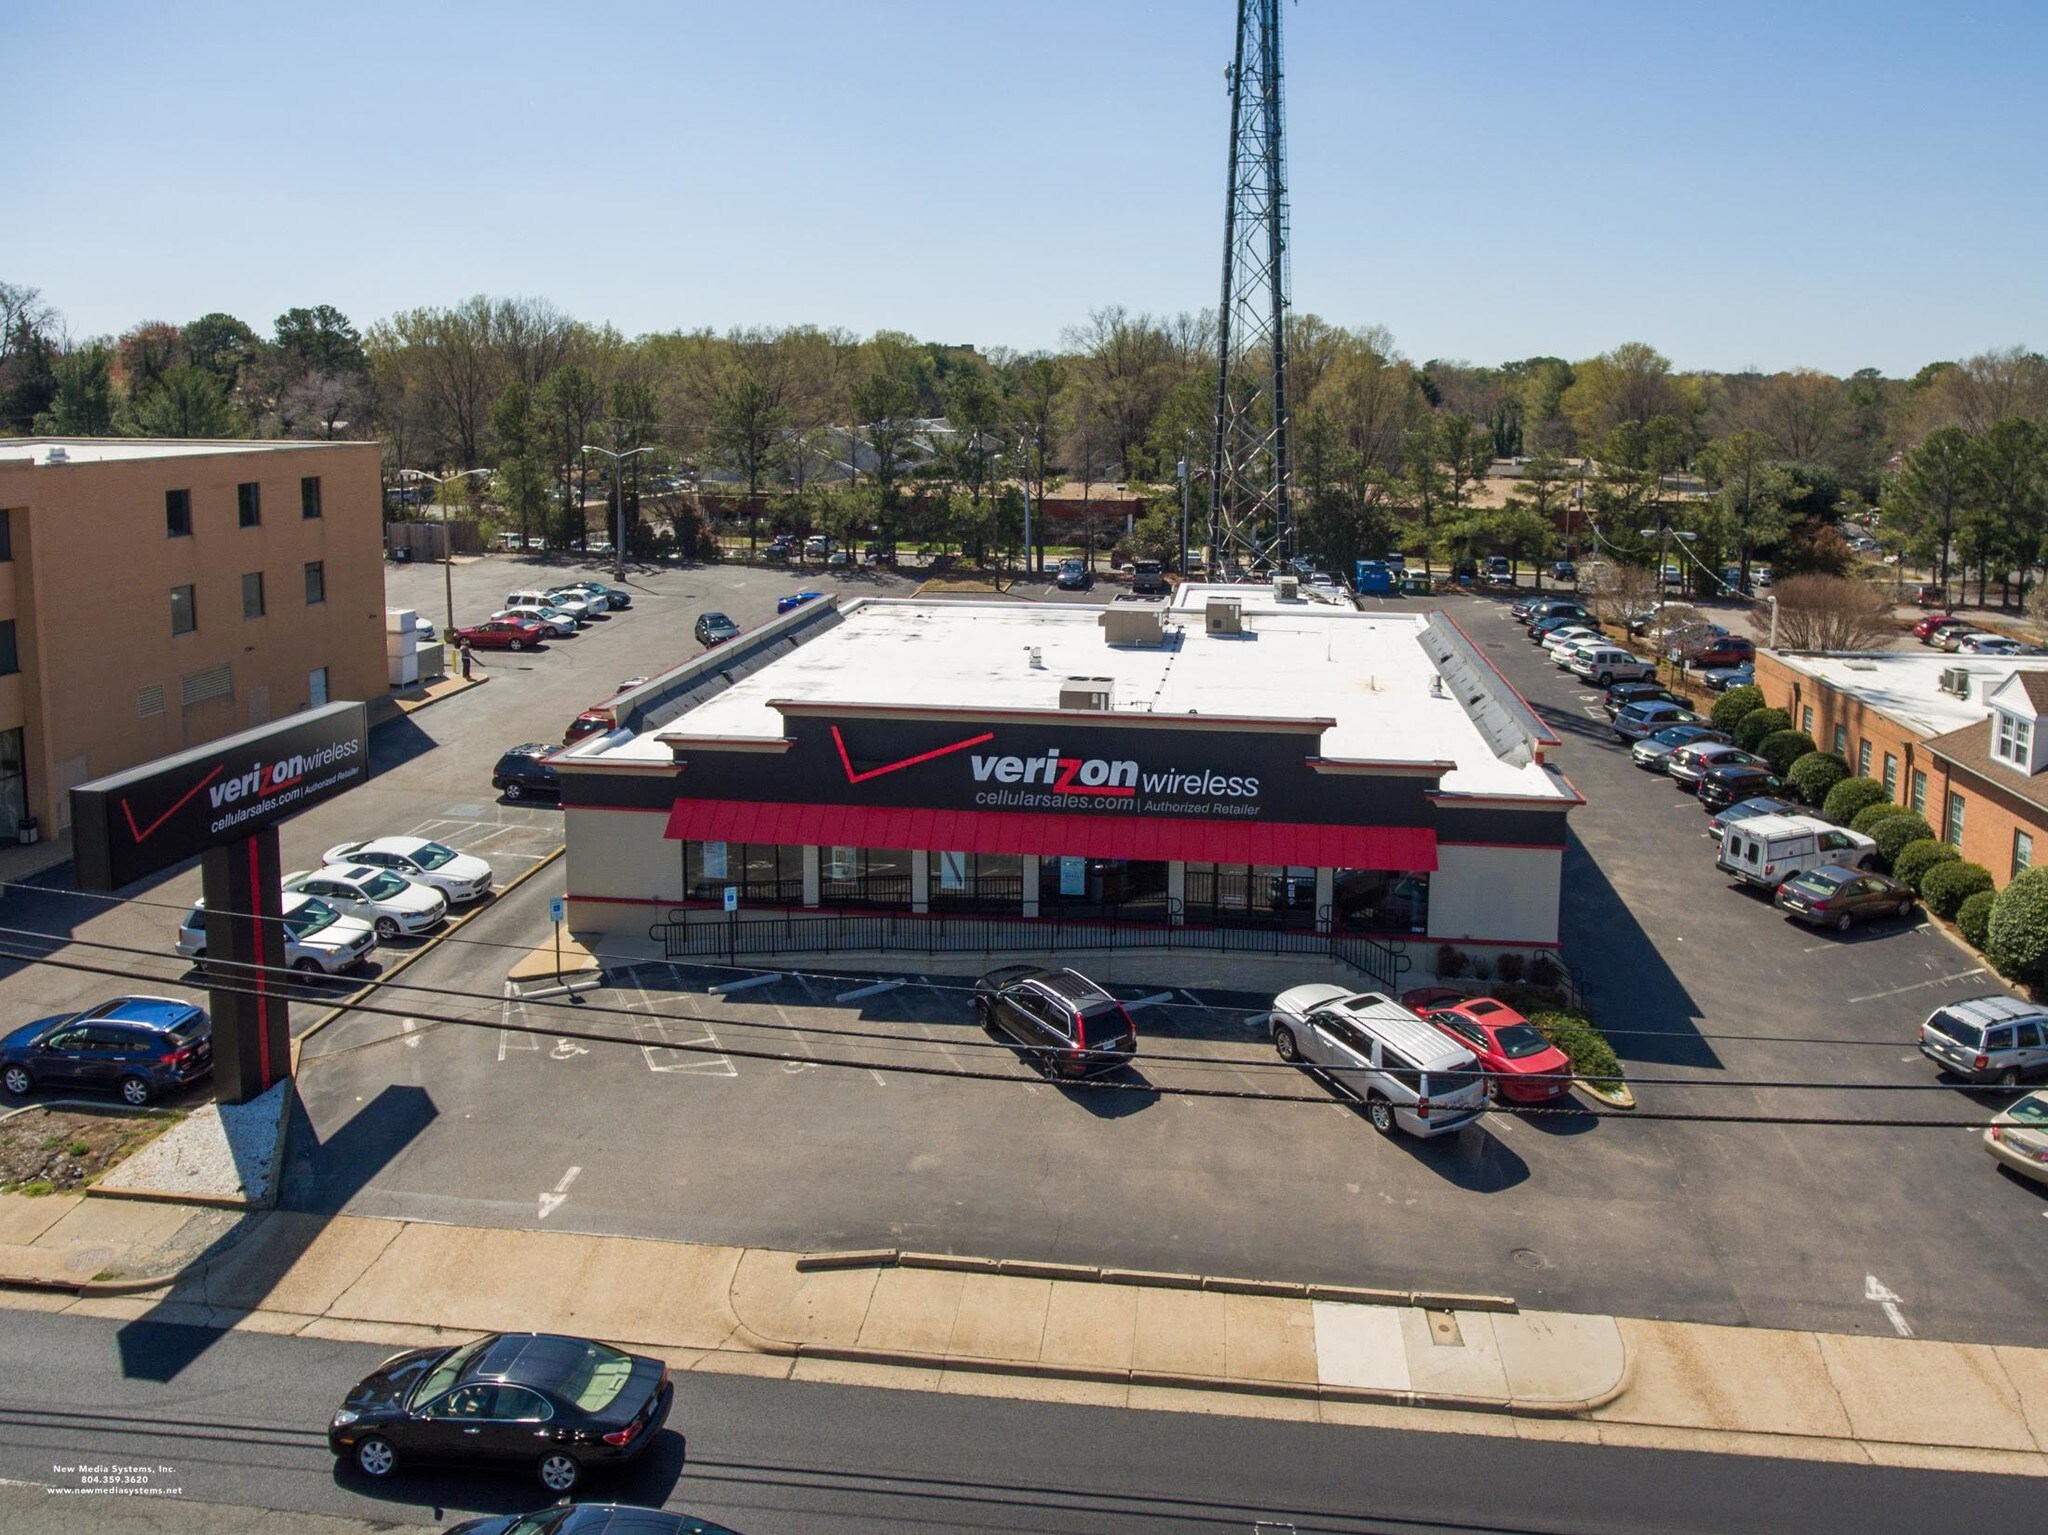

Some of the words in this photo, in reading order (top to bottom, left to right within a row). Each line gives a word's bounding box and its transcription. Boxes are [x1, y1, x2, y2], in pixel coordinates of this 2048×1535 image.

[209, 753, 303, 808] verizon
[303, 738, 358, 772] wireless
[971, 748, 1138, 796] verizon
[1143, 768, 1259, 797] wireless
[211, 788, 300, 833] cellularsales.com
[976, 789, 1134, 811] cellularsales.com
[1144, 801, 1209, 814] Authorized
[1213, 803, 1260, 816] Retailer
